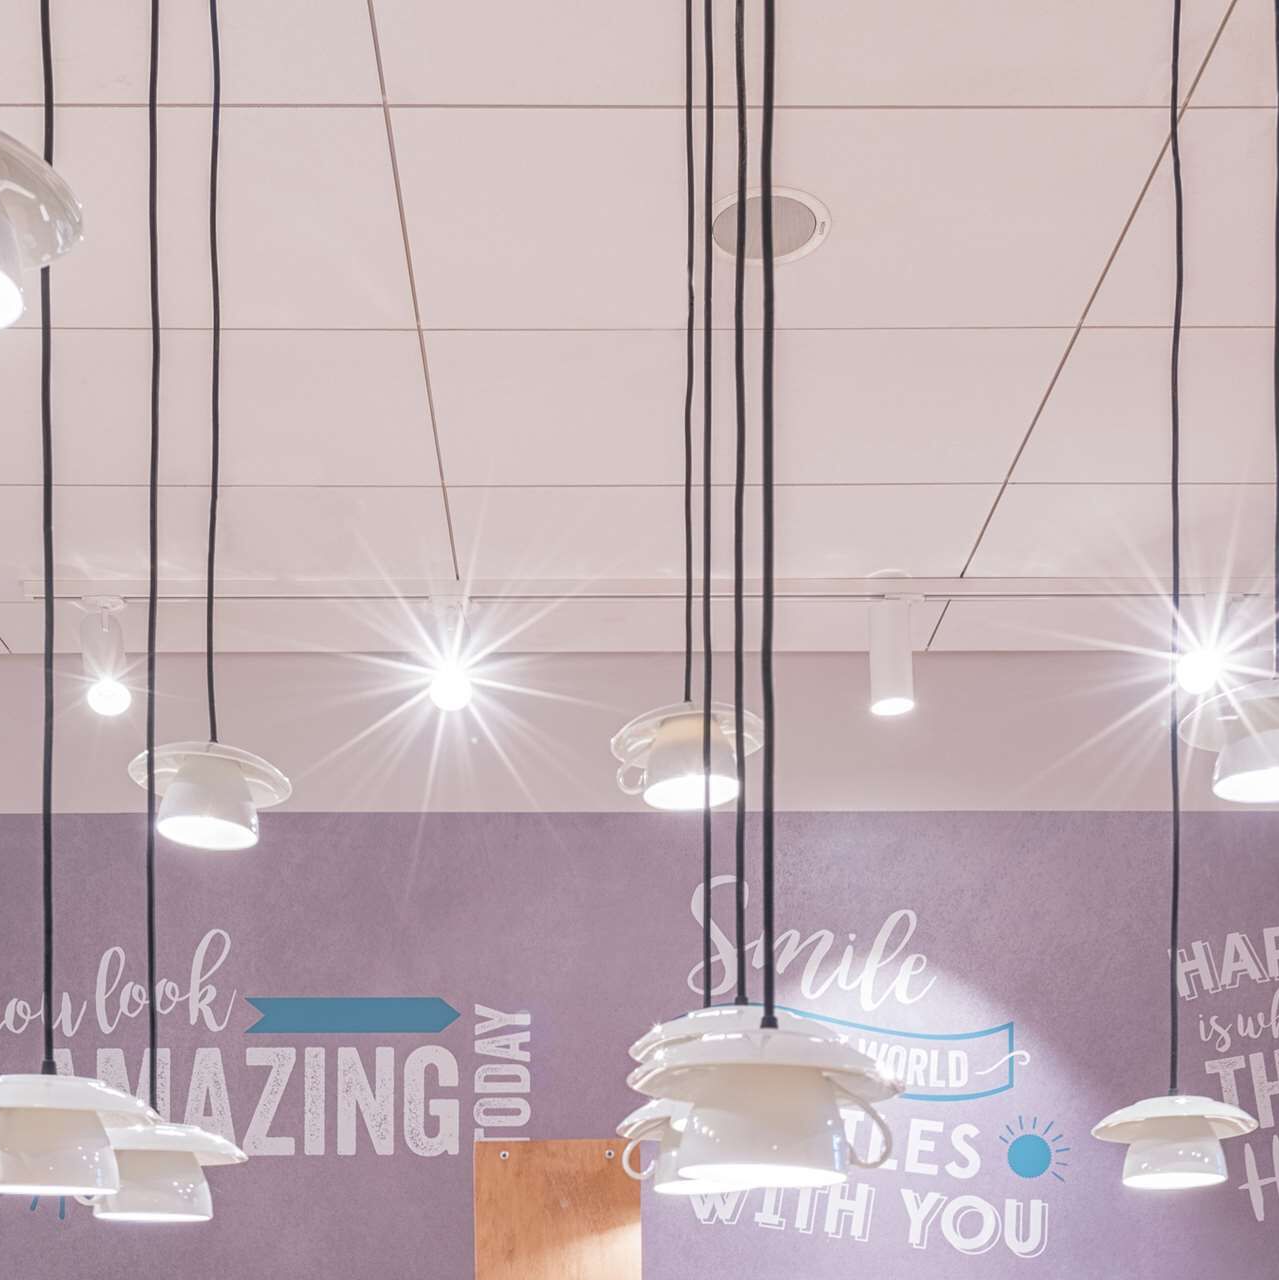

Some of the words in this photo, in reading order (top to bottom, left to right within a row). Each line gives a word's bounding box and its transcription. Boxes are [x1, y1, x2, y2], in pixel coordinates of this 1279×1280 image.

[93, 928, 237, 1036] look
[686, 874, 937, 1011] Smile
[858, 1037, 969, 1089] WORLD
[1198, 1012, 1233, 1053] is
[52, 1046, 459, 1158] MAZING
[687, 1180, 874, 1244] WITH
[899, 1187, 1049, 1259] YOU
